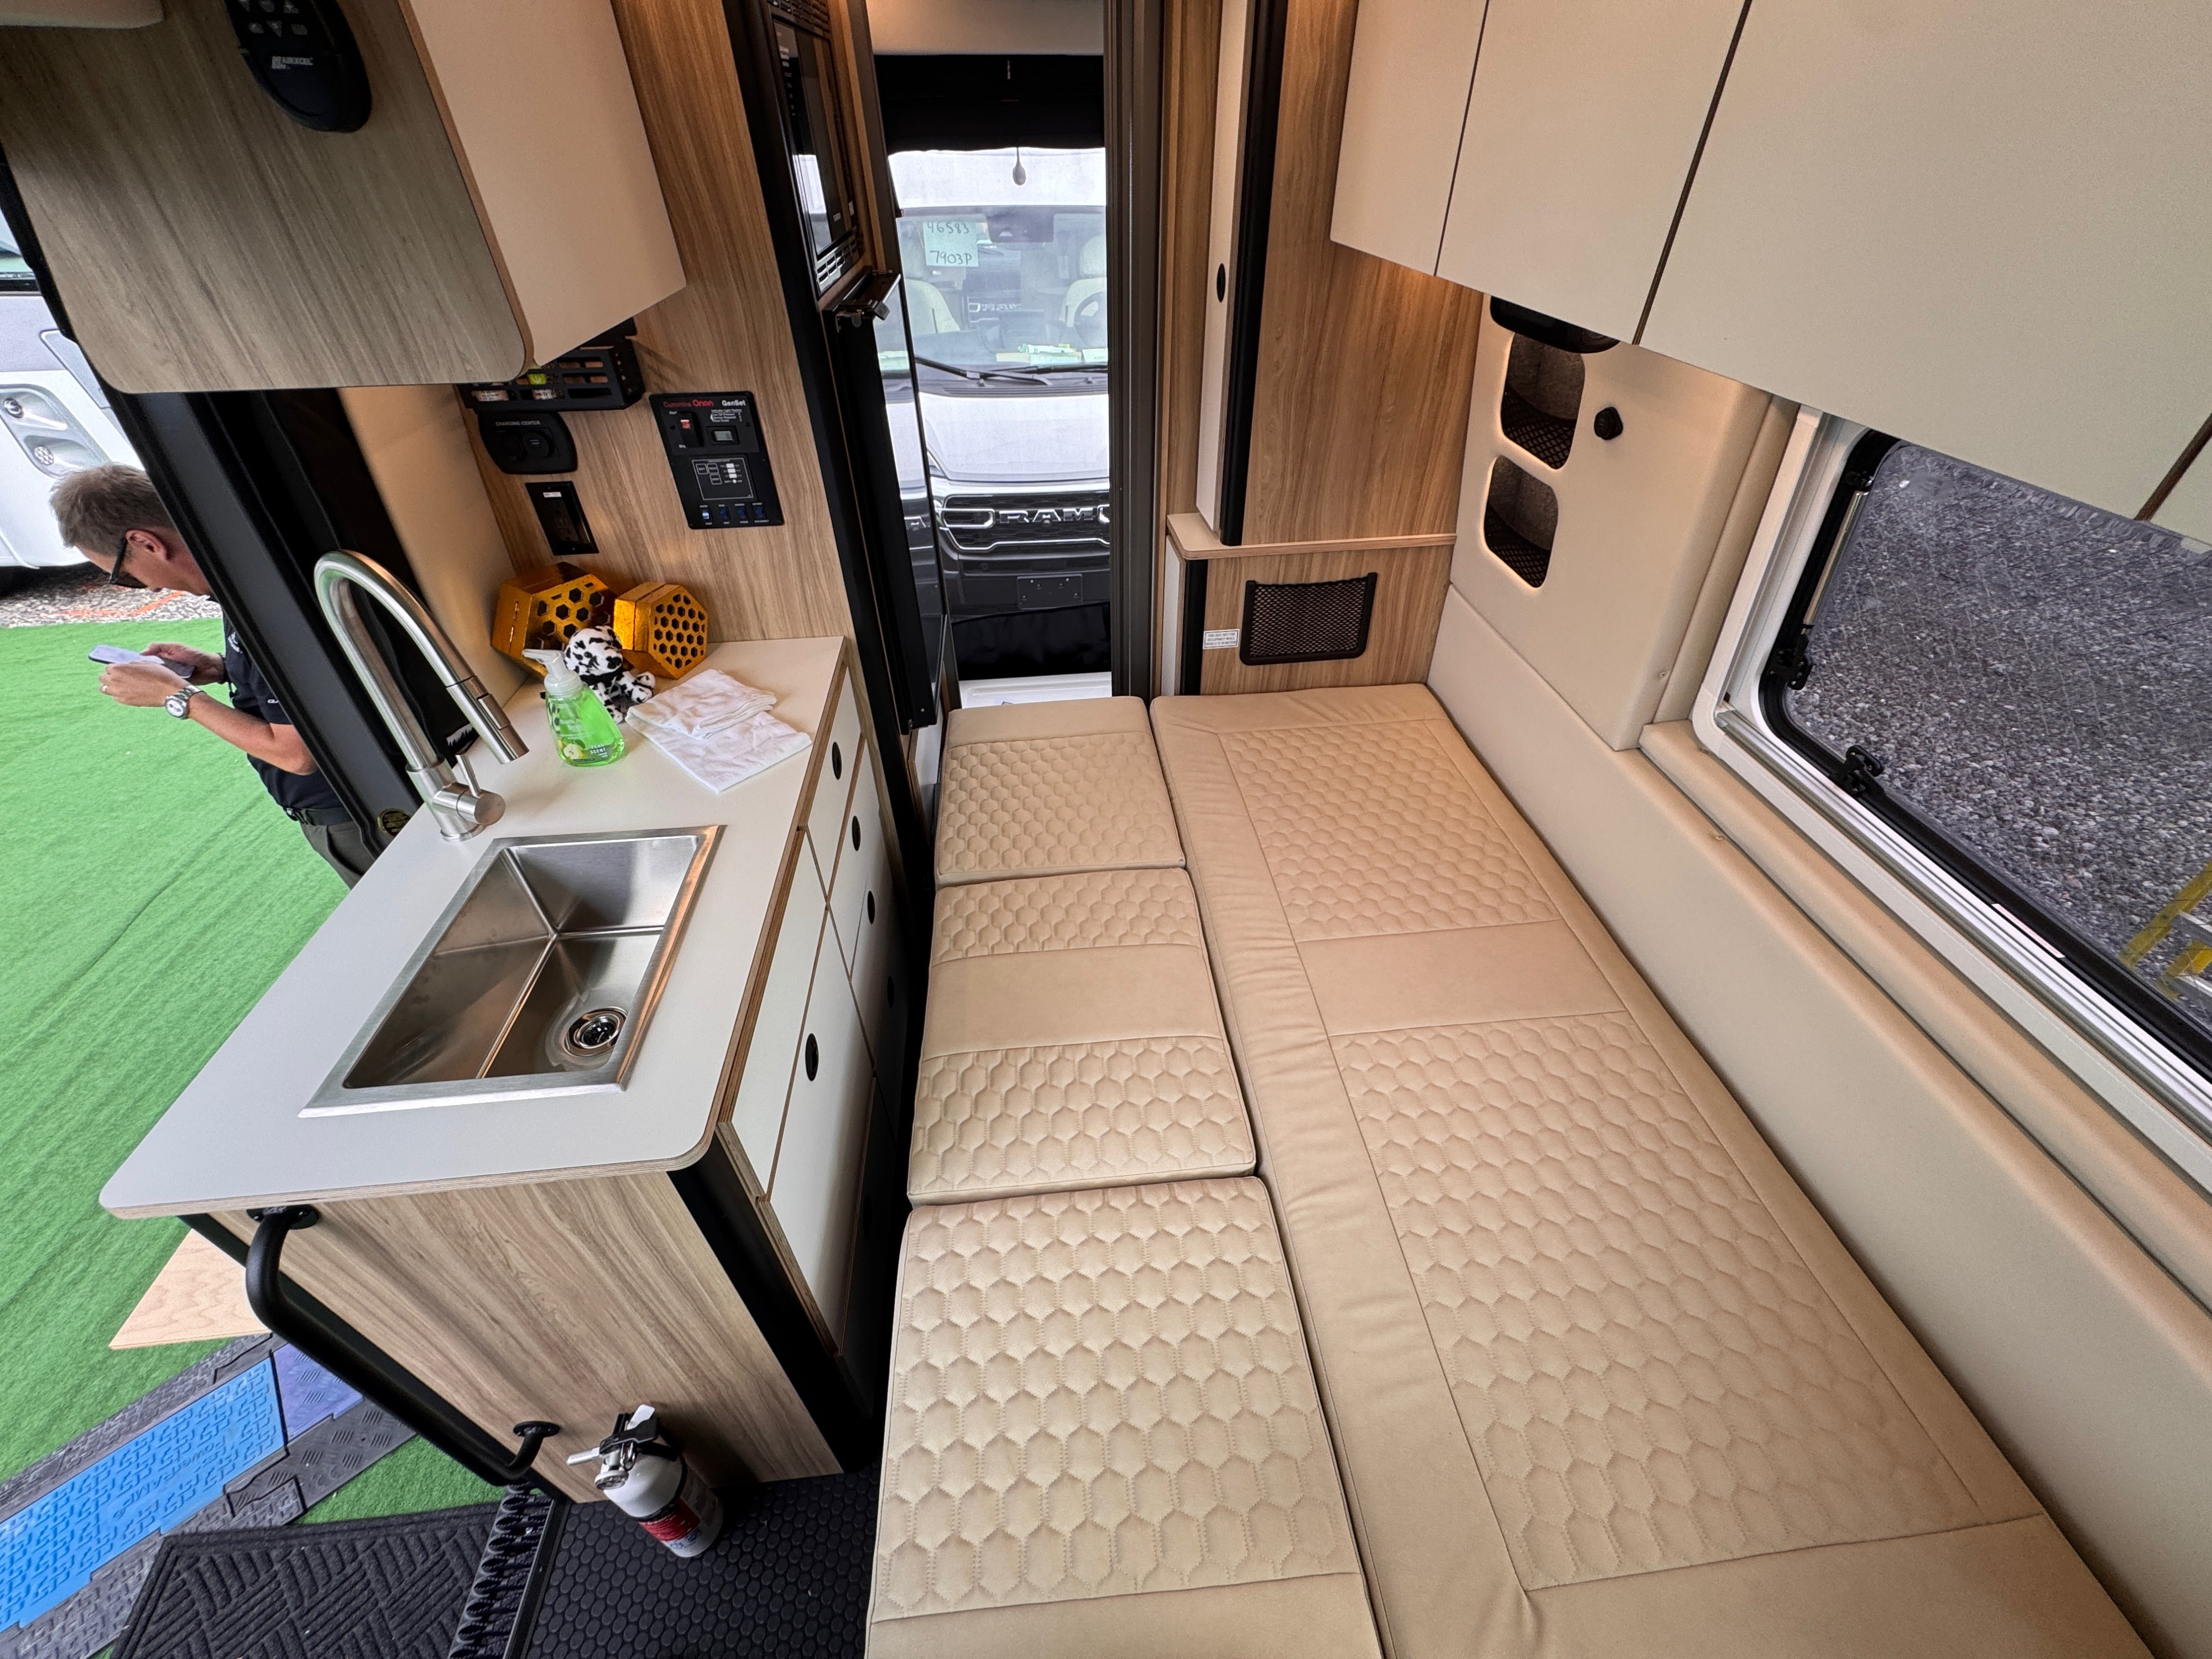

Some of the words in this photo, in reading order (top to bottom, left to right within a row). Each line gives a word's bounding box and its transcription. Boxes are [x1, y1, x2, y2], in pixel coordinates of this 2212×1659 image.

[927, 221, 969, 234] 46583
[930, 250, 972, 265] 7903P
[999, 507, 1094, 524] RAM
